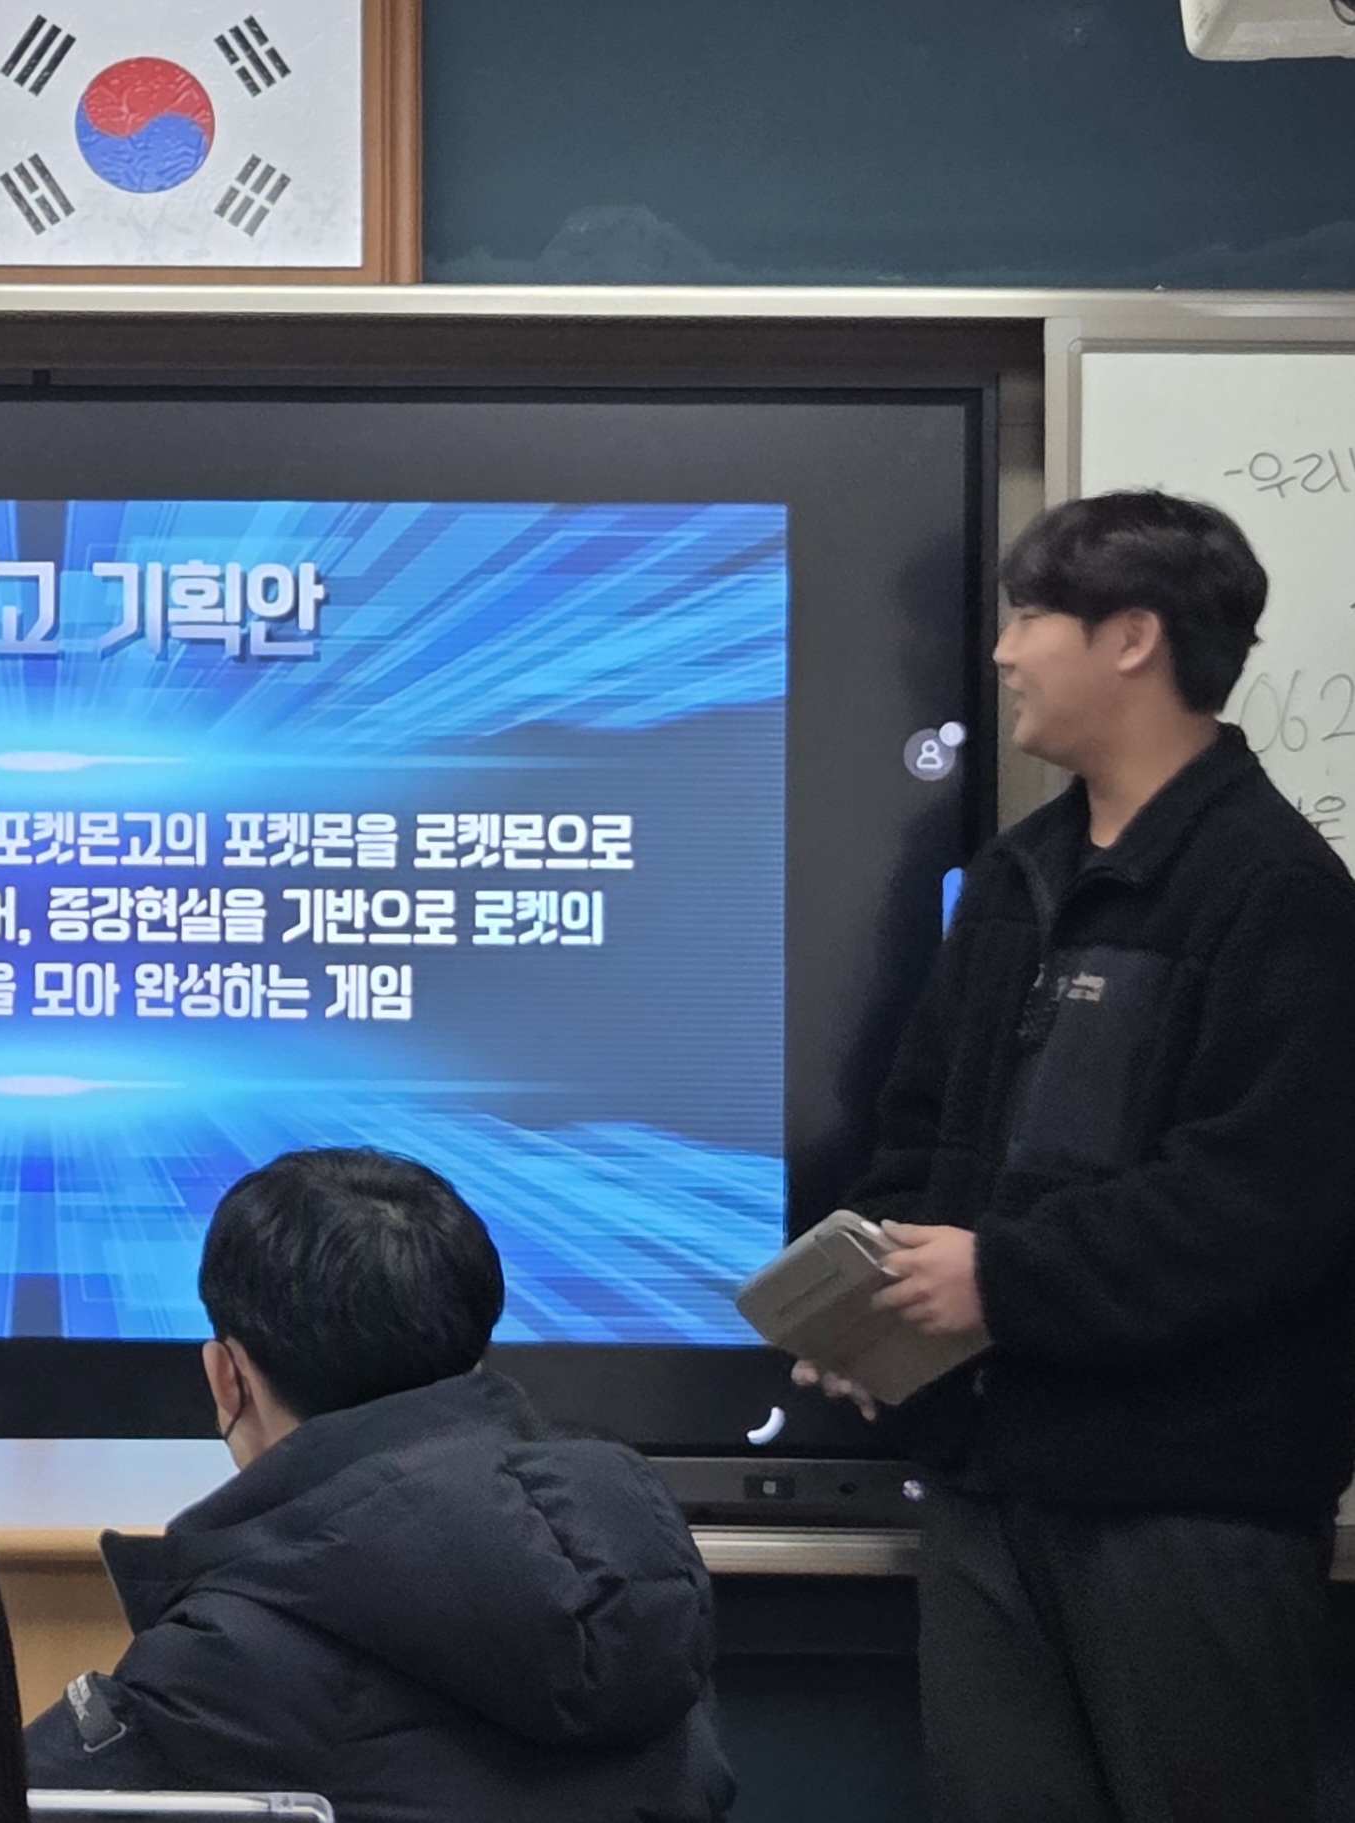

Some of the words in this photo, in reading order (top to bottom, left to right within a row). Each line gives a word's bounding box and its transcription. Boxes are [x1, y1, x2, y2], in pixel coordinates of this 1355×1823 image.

[93, 558, 325, 657] 기획안
[222, 811, 398, 868] 포켓몬을
[413, 813, 634, 870] 로켓몬으로
[47, 886, 267, 944] 증강현실을
[282, 887, 457, 945] 기반으로
[472, 889, 604, 946] 로켓의
[32, 962, 119, 1018] 모아
[135, 962, 310, 1020] 완성하는
[325, 964, 414, 1020] 게임
